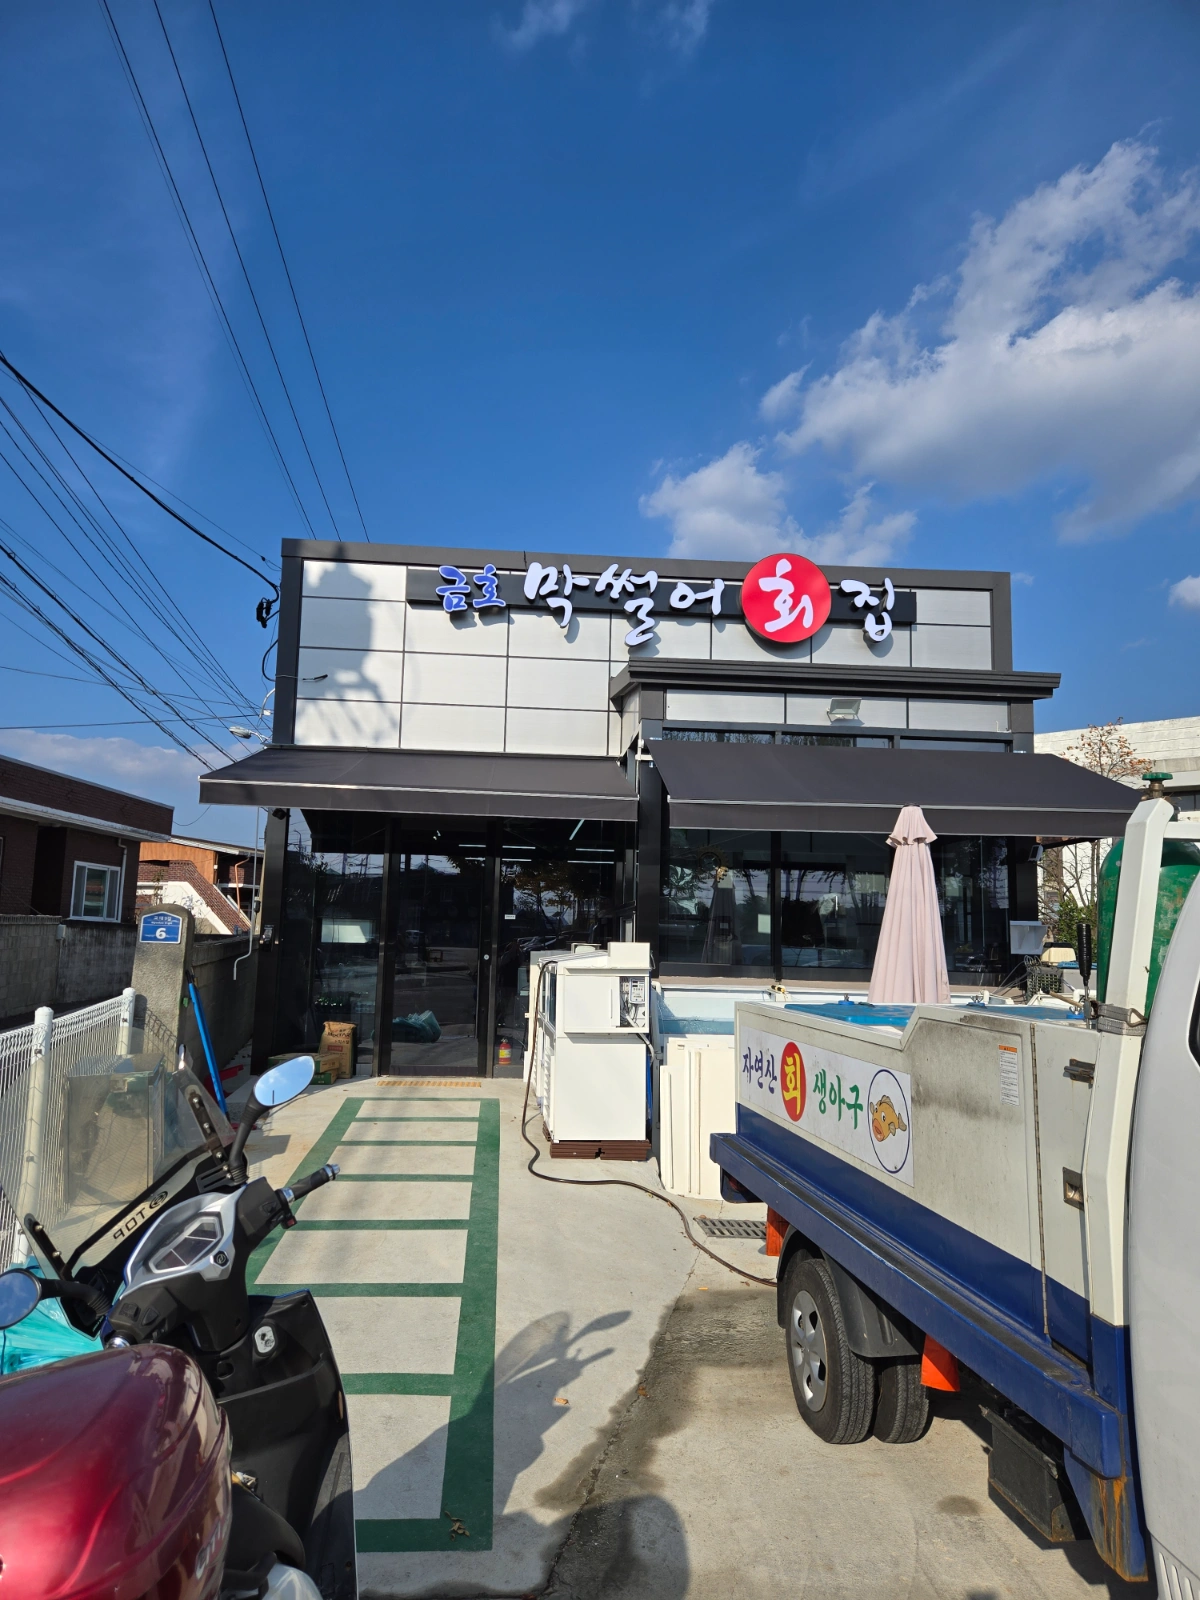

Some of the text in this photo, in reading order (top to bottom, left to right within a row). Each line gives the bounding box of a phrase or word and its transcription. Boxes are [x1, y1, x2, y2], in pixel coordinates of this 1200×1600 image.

[436, 563, 506, 612] 금호
[523, 562, 725, 646] 막썰어
[155, 927, 167, 940] 6
[742, 1046, 864, 1130] 자연산 회 생아구
